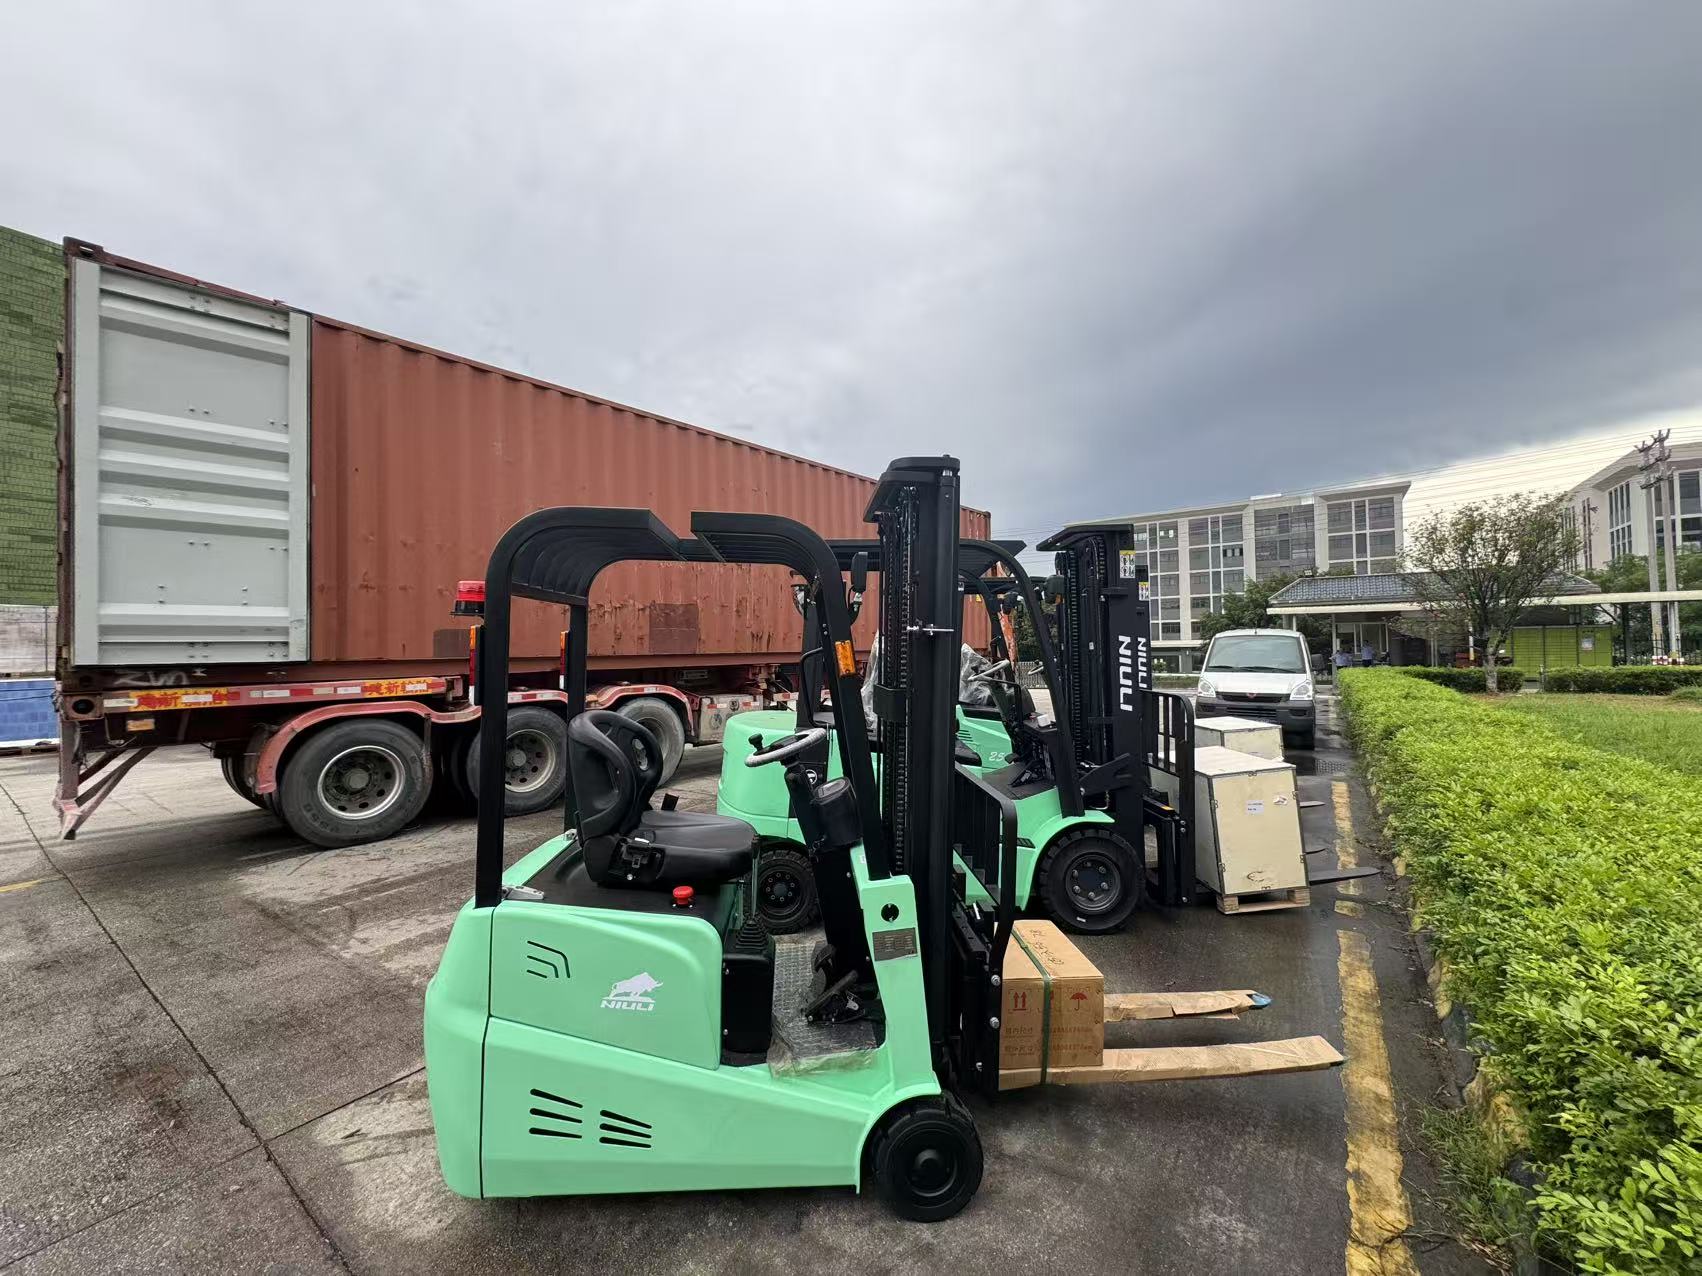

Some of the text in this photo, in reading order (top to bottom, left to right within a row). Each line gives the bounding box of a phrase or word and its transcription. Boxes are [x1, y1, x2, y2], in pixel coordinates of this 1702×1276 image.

[1118, 635, 1133, 711] NIULI
[1137, 637, 1147, 688] NIULI
[600, 1000, 655, 1011] NIULI
